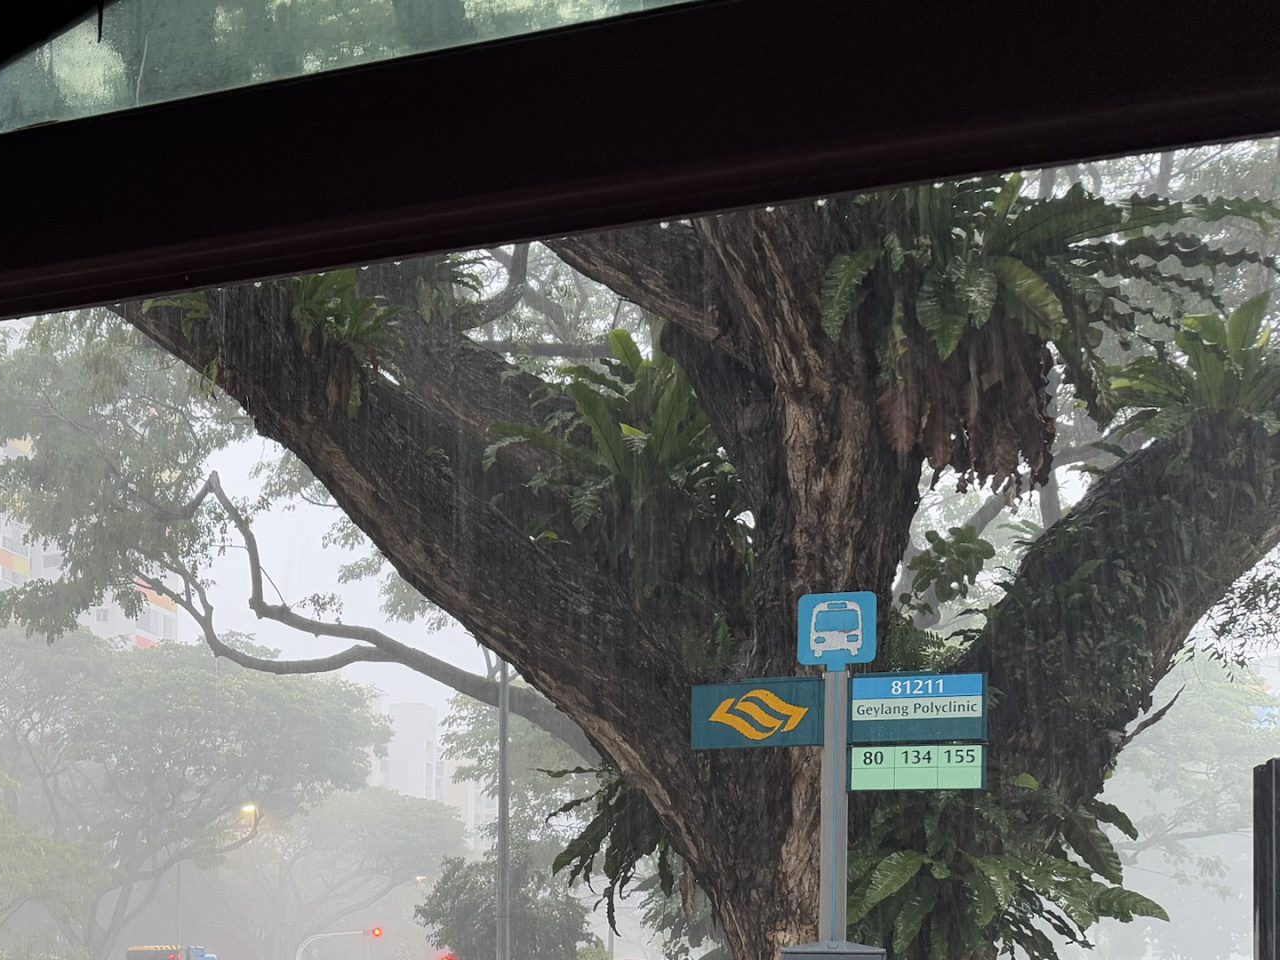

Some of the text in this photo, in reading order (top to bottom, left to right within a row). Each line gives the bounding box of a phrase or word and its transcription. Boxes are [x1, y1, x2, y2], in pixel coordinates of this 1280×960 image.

[891, 679, 944, 695] 81211
[856, 701, 978, 717] Geylang Polyclinic
[863, 749, 975, 765] 80 134 155
